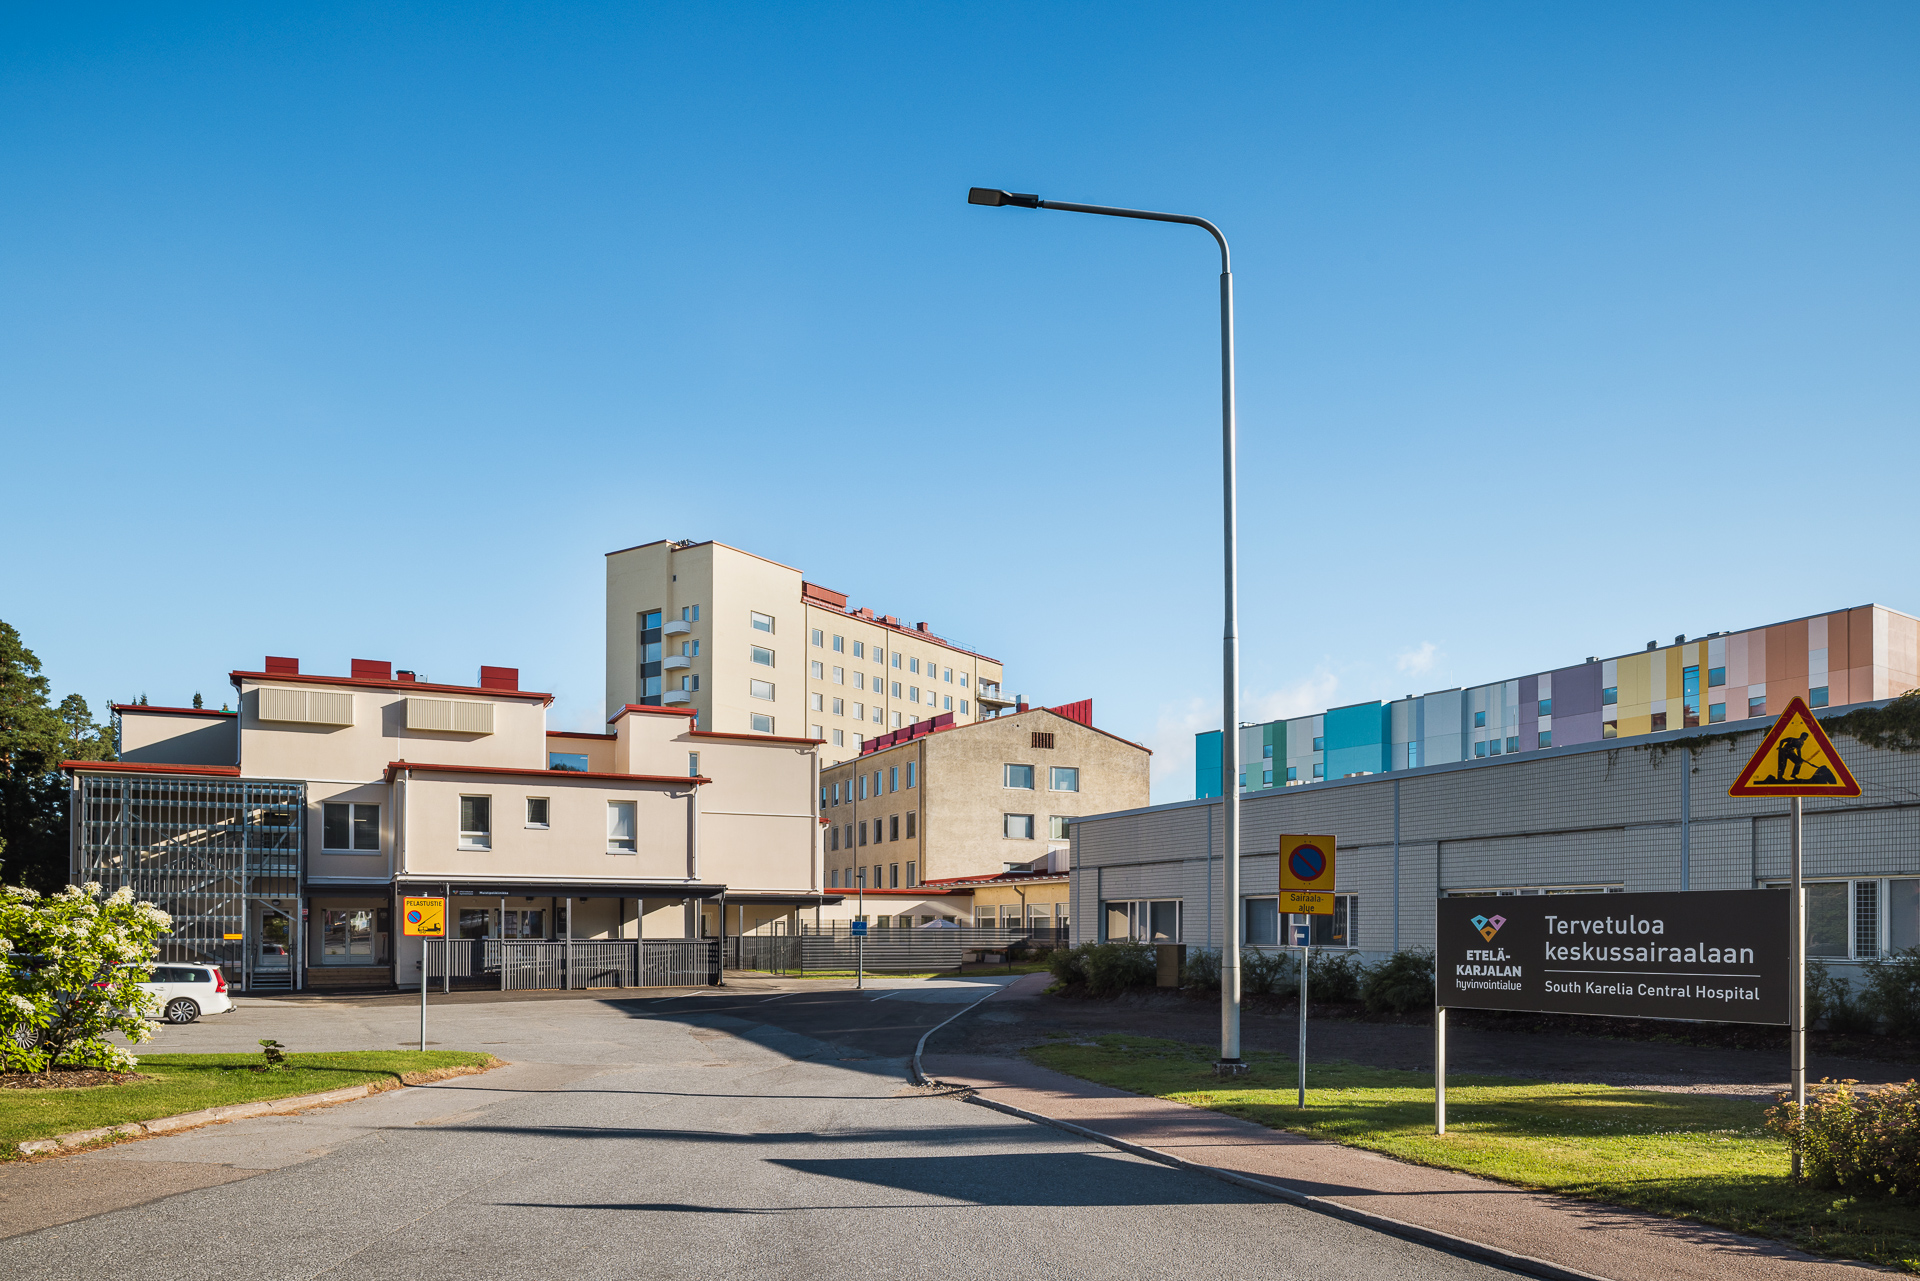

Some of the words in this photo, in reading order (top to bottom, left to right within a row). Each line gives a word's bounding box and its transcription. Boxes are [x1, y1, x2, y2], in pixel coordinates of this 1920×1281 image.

[1290, 893, 1324, 903] Sairaala-
[1298, 904, 1315, 912] alue
[1544, 914, 1664, 935] Tervetuloa
[1466, 947, 1511, 962] ETELÄ-
[1545, 941, 1754, 964] keskussairaalaan
[1456, 964, 1522, 977] KARJALAN
[1456, 978, 1522, 991] hyvinvointialue
[1544, 980, 1581, 993] South
[1585, 981, 1633, 996] Karelia
[1637, 983, 1691, 998] Central
[1695, 985, 1760, 1002] Hospital
